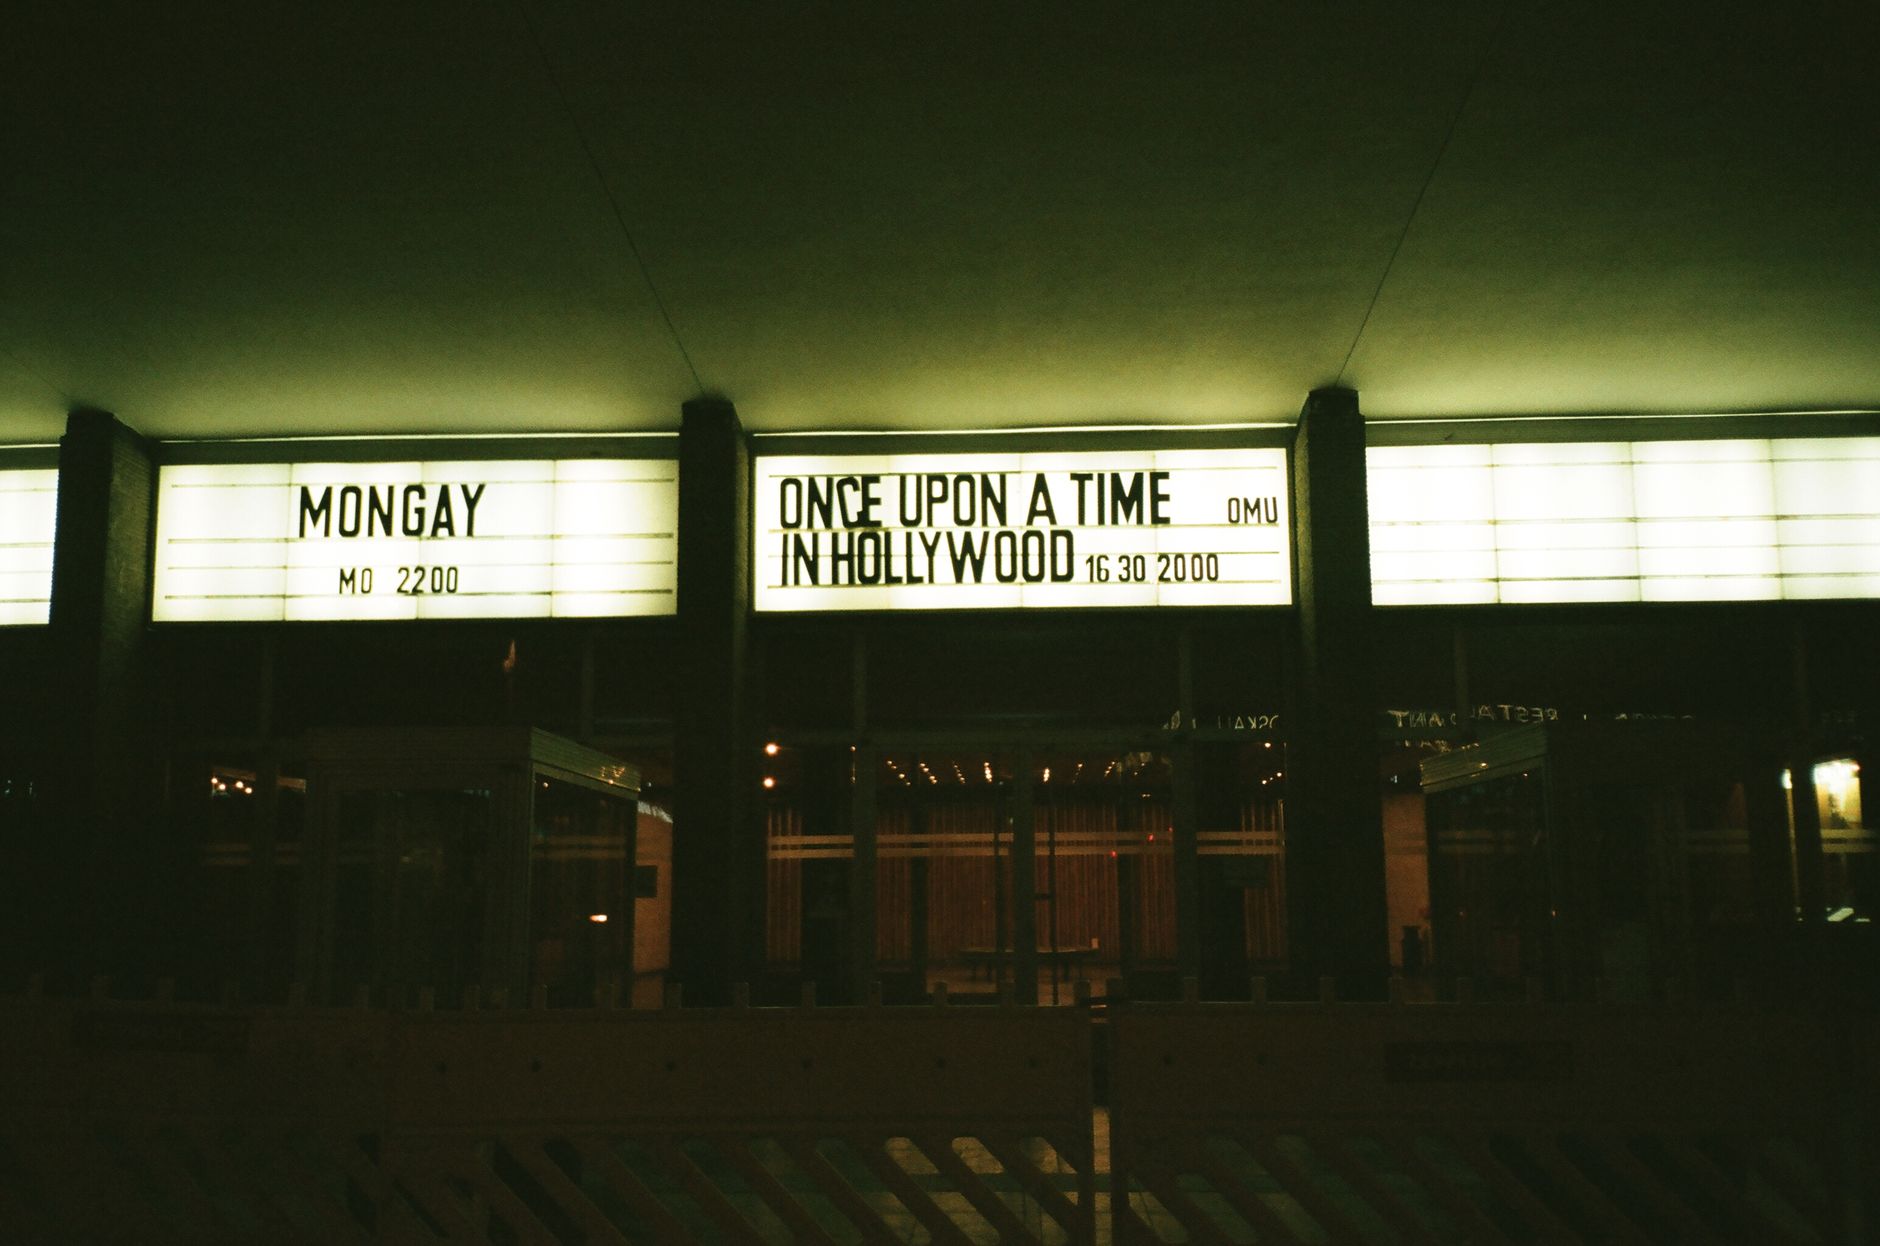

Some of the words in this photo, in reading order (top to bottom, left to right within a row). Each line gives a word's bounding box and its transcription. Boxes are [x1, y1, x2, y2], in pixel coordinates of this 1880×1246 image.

[299, 484, 486, 538] MONGAY
[780, 476, 881, 528] ONCE
[900, 475, 1006, 527] UPON
[1026, 473, 1056, 525] A
[1070, 471, 1171, 525] TIME
[1228, 497, 1278, 523] OMU
[781, 532, 818, 586] IN
[832, 529, 1074, 585] HOLLYWOOD
[1158, 553, 1218, 582] 2000
[339, 568, 372, 595] MO
[397, 566, 459, 595] 2200
